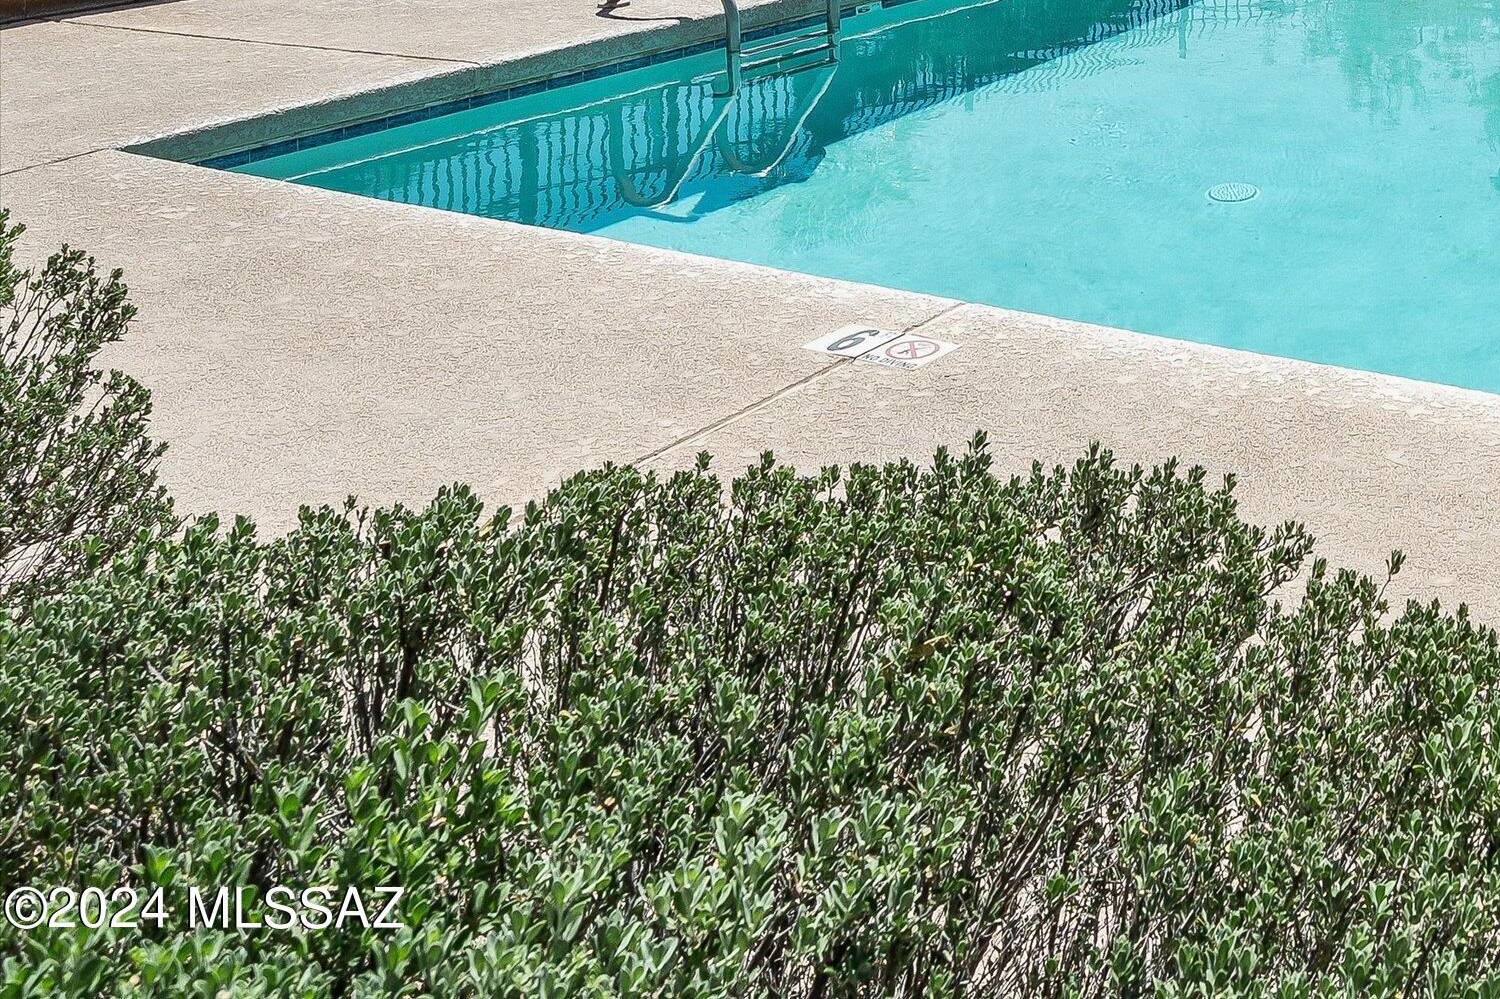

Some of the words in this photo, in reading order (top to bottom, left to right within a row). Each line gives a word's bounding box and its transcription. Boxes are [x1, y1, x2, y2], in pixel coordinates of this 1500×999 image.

[827, 329, 880, 351] 6
[862, 353, 879, 361] NO
[880, 357, 918, 369] DIVING
